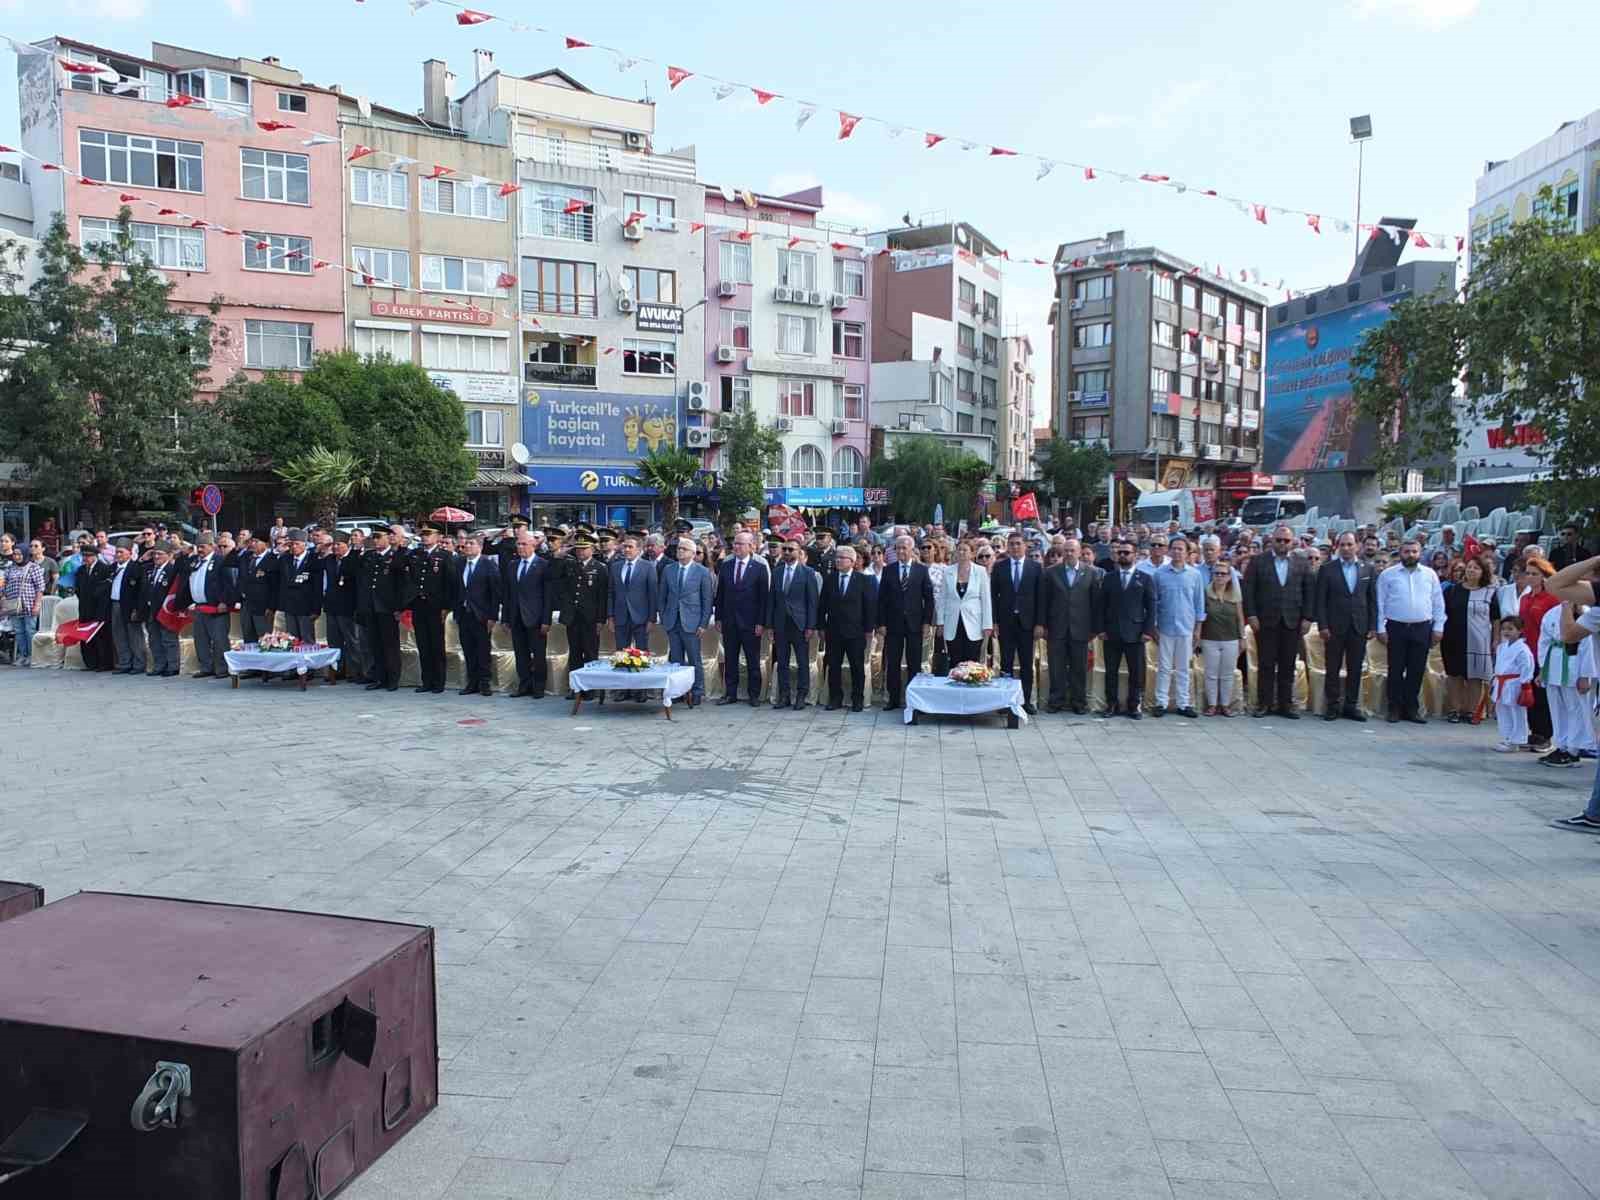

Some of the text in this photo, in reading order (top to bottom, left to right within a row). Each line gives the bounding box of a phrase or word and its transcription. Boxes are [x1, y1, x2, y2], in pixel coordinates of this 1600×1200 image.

[392, 309, 424, 318] EMEK
[639, 306, 682, 321] AVUKAT
[547, 400, 621, 417] Turkcell'le
[547, 416, 600, 433] bağlan
[547, 432, 606, 448] hayata!
